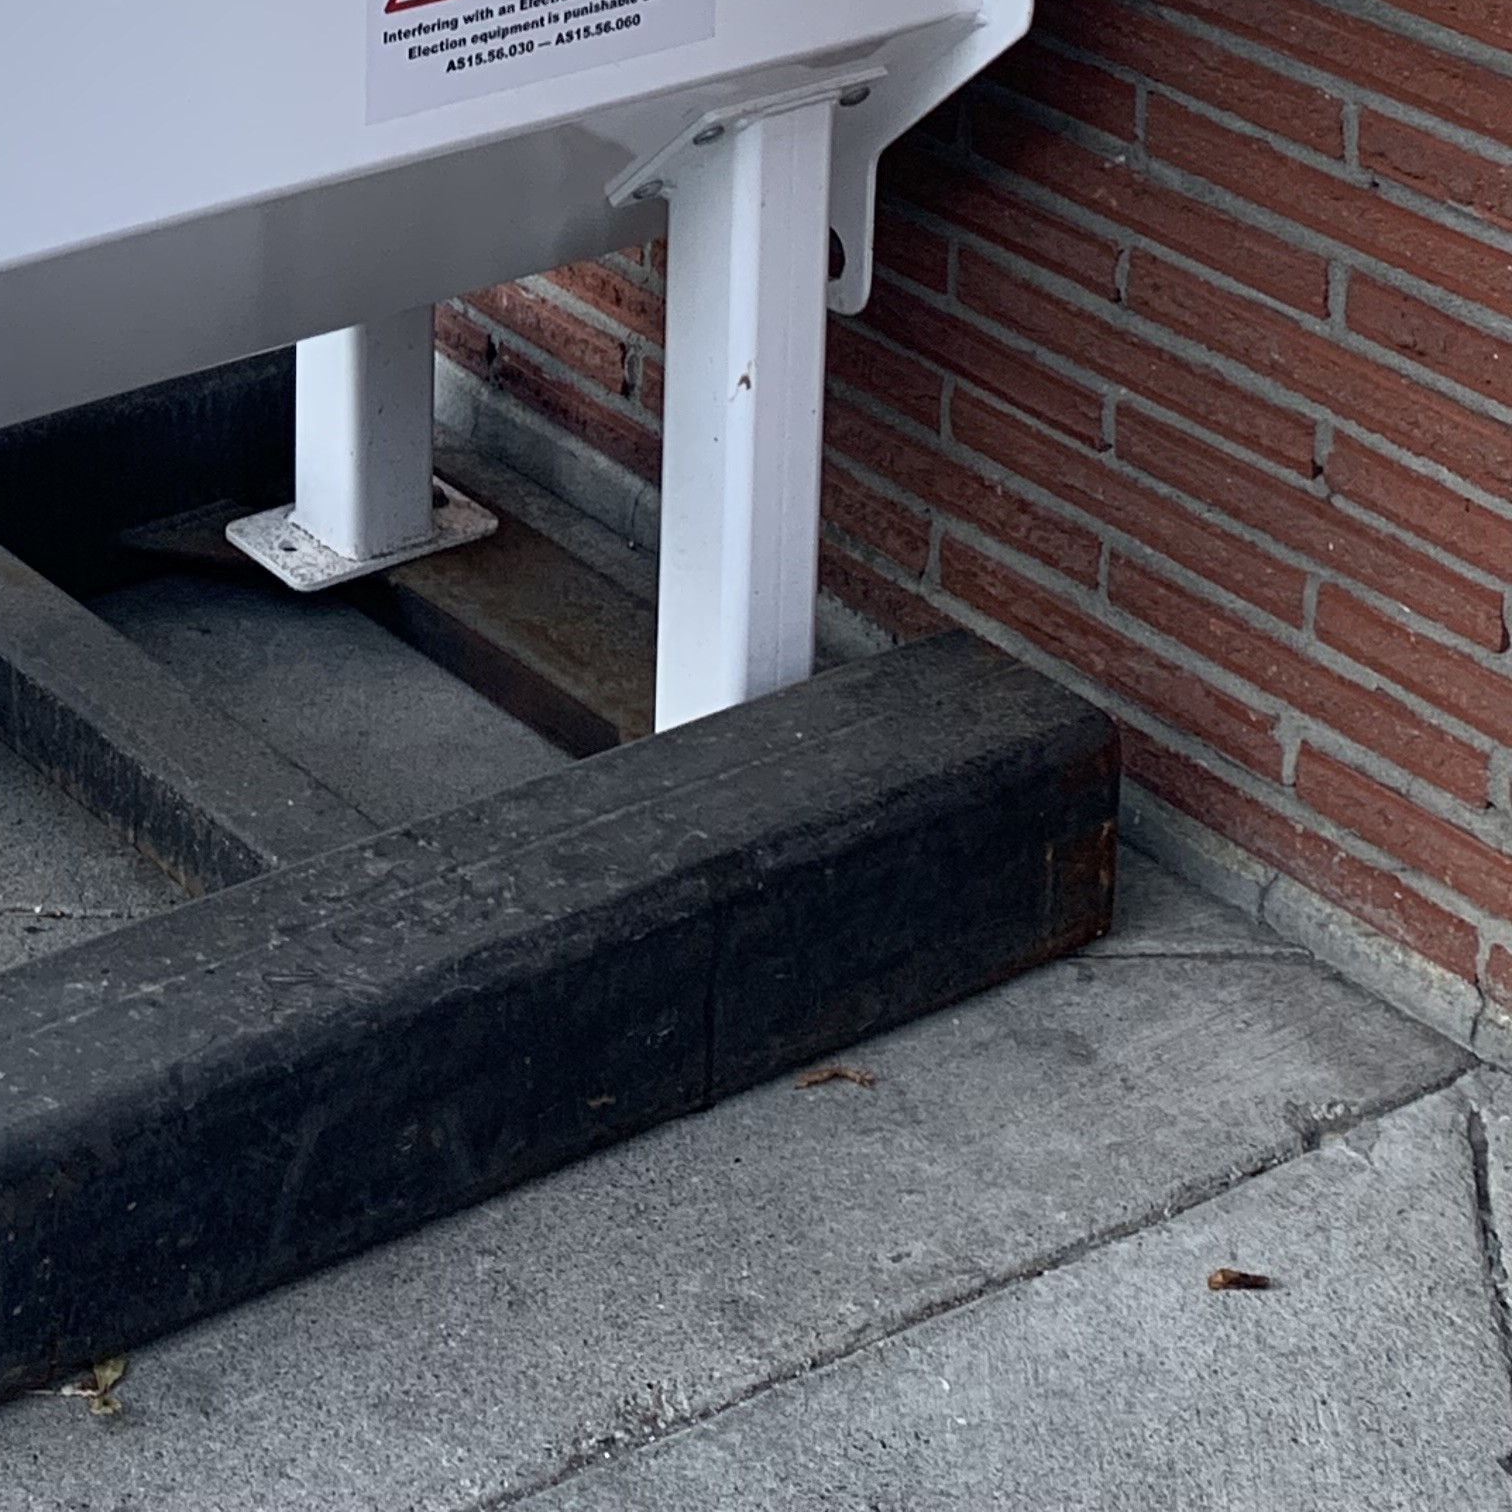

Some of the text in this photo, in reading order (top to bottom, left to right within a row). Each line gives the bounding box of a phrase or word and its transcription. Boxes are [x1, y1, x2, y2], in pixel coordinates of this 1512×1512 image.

[382, 17, 458, 44] Interfering
[462, 6, 494, 24] with
[497, 3, 515, 16] an
[407, 36, 467, 60] Election
[470, 15, 545, 44] equipment
[547, 11, 560, 24] is
[445, 39, 534, 73] AS15.56.030
[555, 12, 641, 46] AS15.56.060
